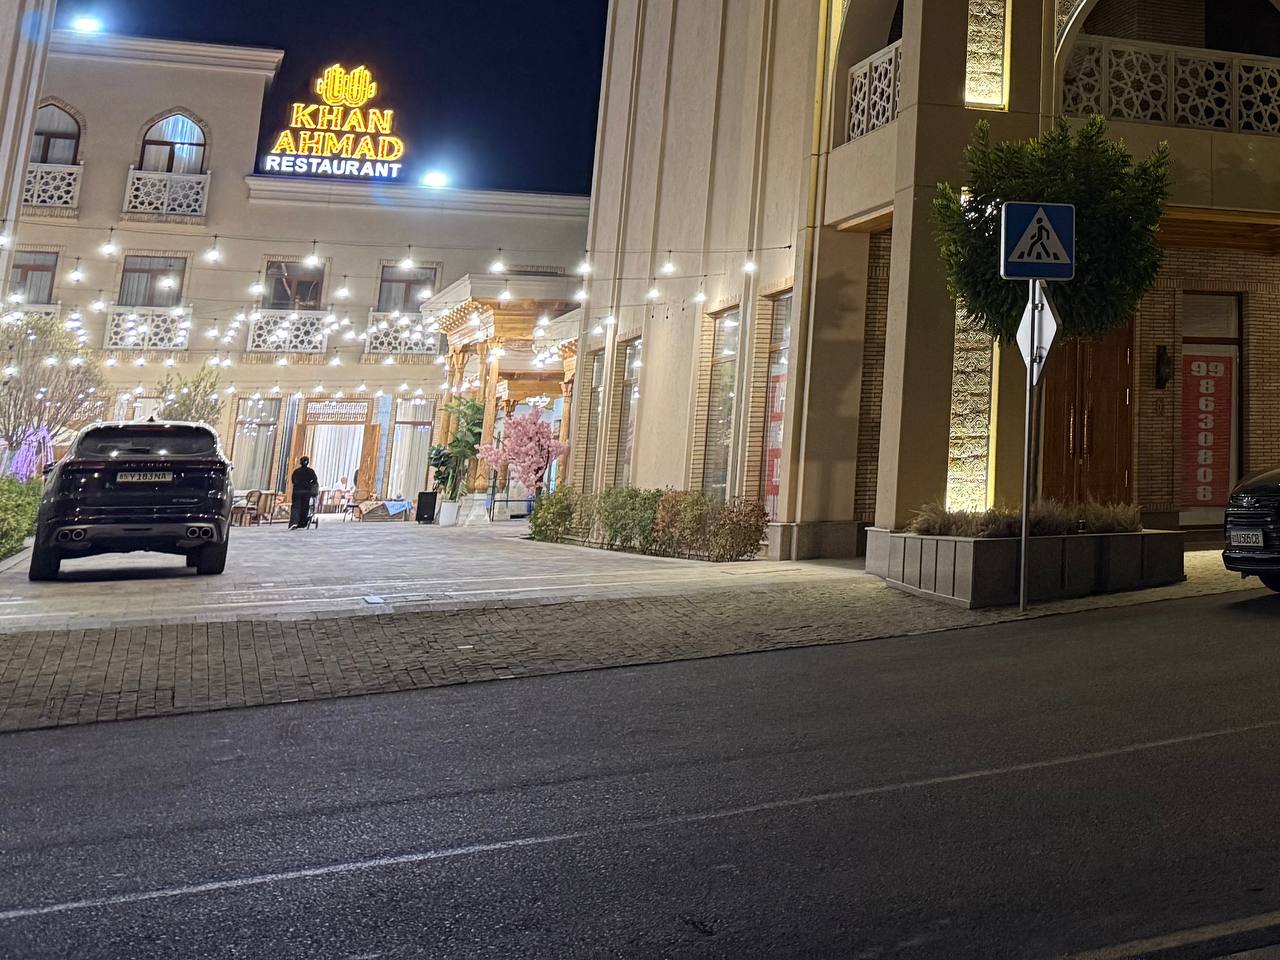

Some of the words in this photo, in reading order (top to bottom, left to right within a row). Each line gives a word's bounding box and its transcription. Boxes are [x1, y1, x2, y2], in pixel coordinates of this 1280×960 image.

[290, 102, 394, 134] KHAN
[271, 129, 404, 161] AHMAD
[265, 155, 402, 178] RESTAURANT
